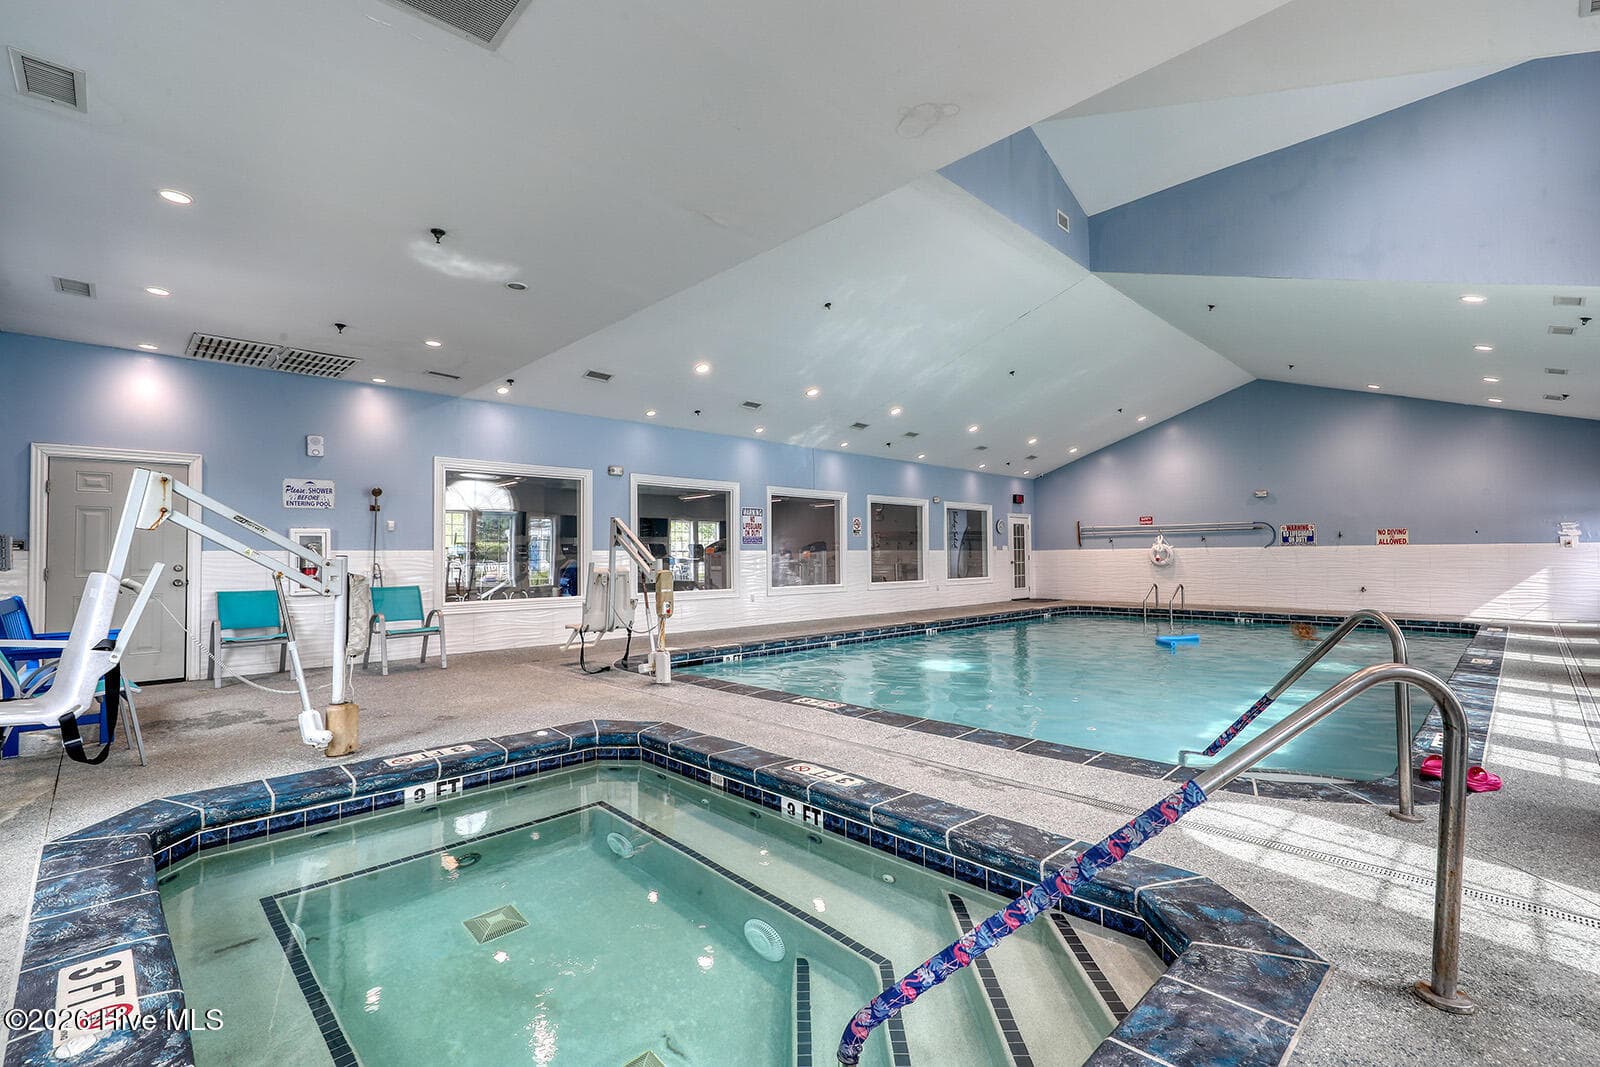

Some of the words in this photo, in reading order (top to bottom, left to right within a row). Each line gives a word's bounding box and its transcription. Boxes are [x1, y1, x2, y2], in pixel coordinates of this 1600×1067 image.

[1387, 528, 1407, 536] DIVING
[808, 770, 838, 779] FT
[437, 778, 460, 795] FT
[803, 804, 821, 825] FT
[68, 959, 123, 981] 3
[67, 975, 126, 1008] FT
